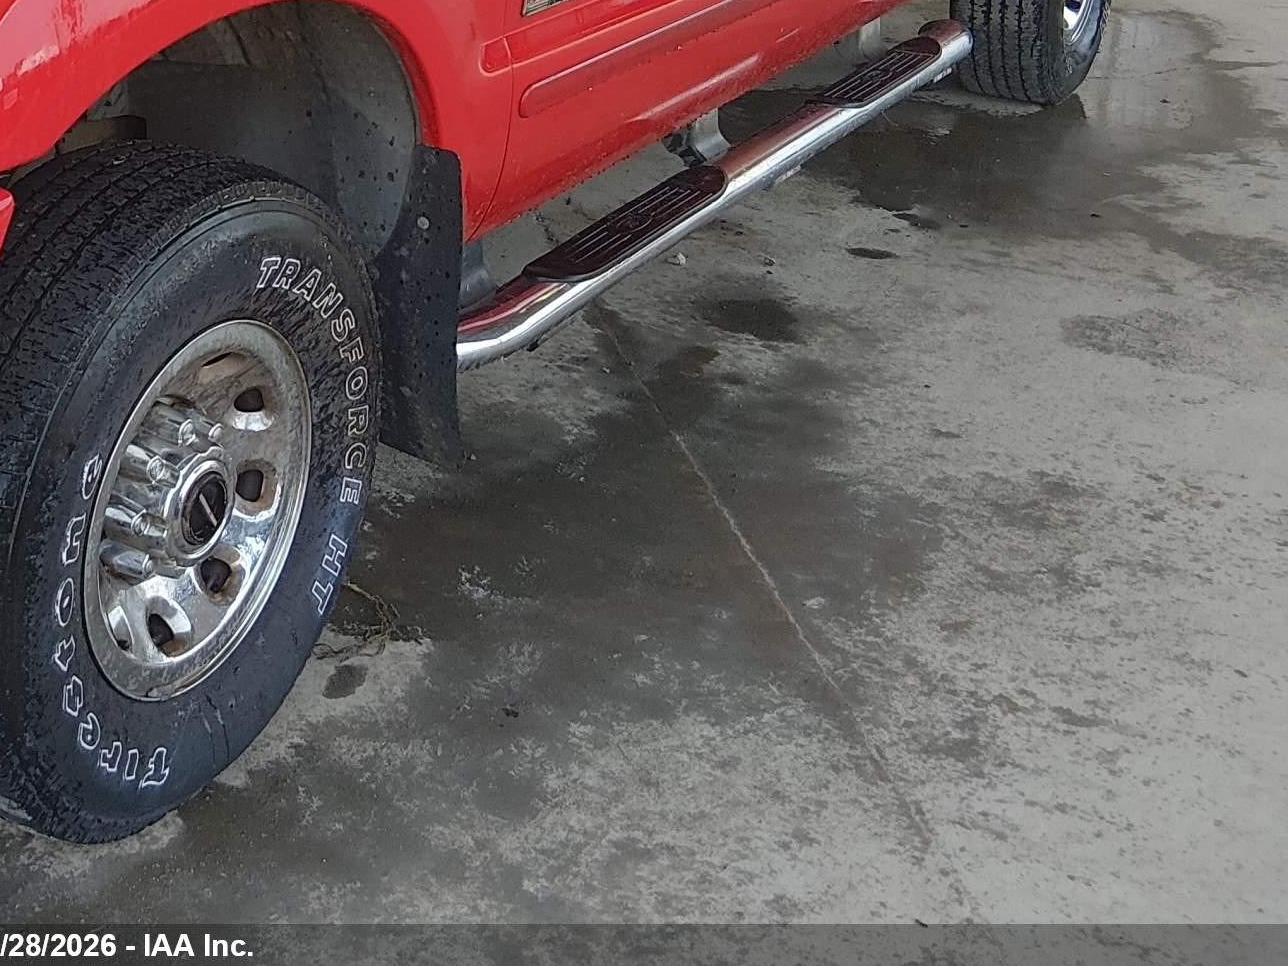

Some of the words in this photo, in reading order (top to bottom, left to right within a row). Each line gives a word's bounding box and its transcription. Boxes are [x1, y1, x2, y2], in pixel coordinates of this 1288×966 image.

[256, 256, 369, 506] TRANSFORCE
[54, 454, 170, 789] Firestone
[312, 533, 349, 616] HT
